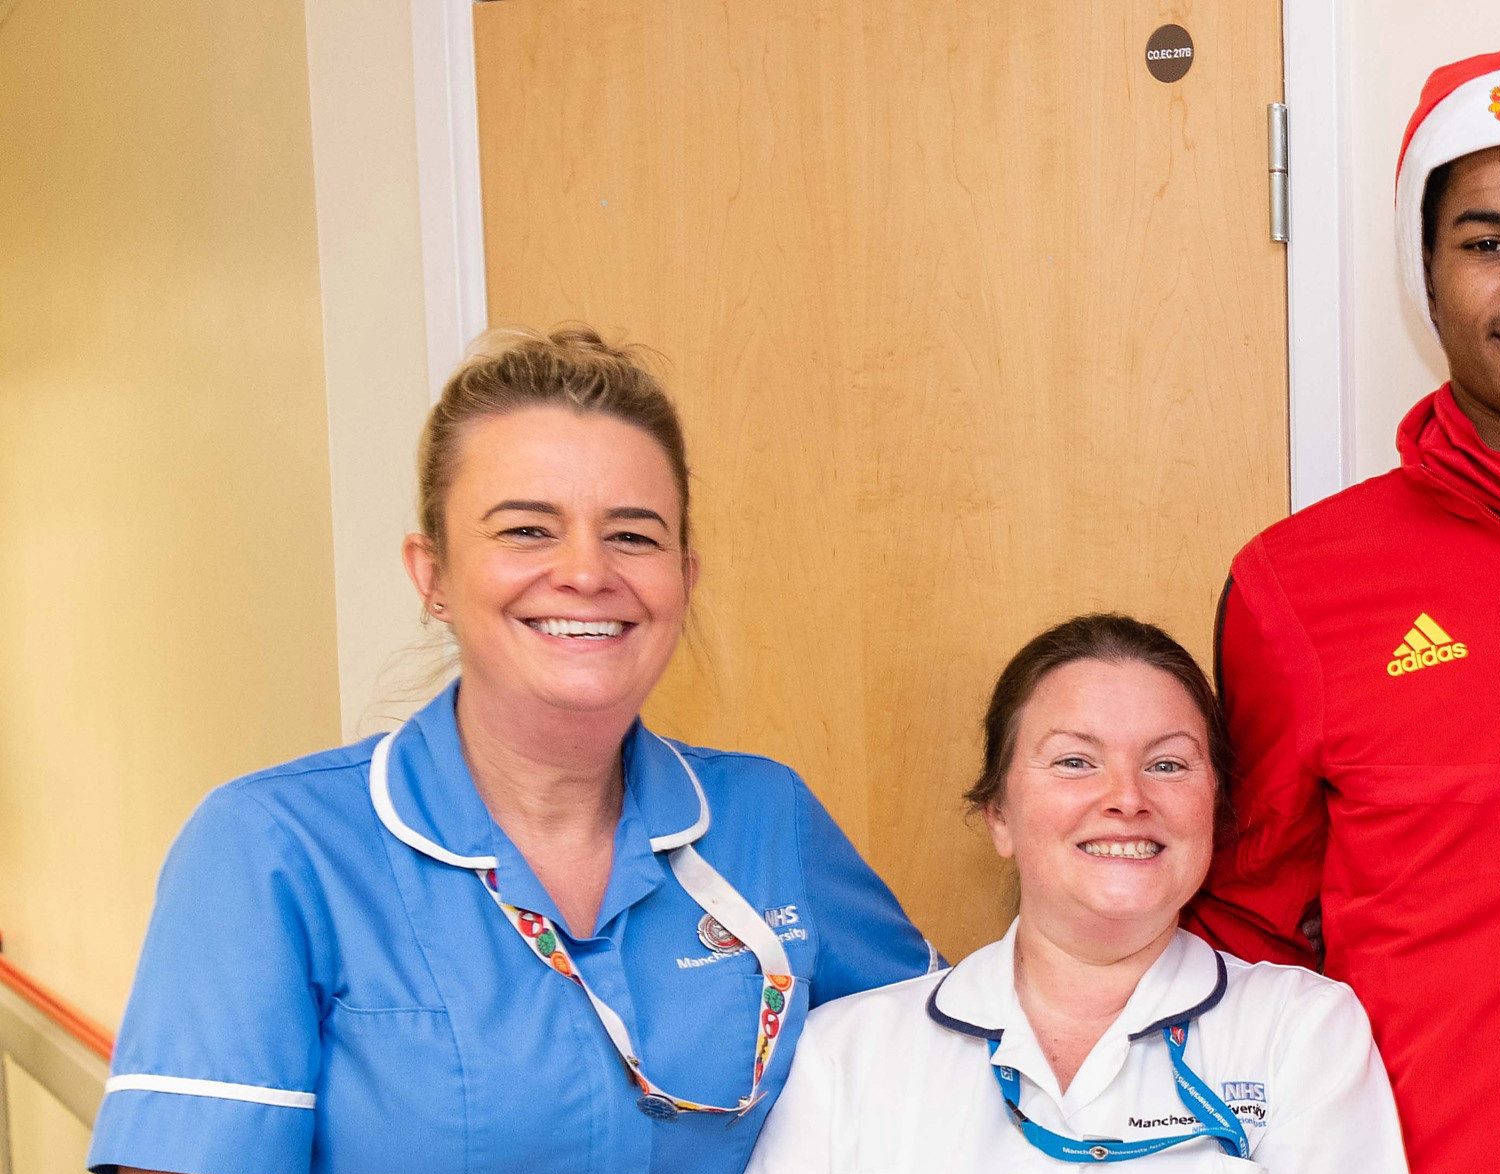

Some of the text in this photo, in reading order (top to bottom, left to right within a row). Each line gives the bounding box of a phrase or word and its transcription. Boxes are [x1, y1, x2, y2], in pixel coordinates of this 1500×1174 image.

[1386, 642, 1468, 676] adidas
[779, 928, 807, 944] rsity
[1224, 1083, 1264, 1101] NHS
[1129, 1114, 1201, 1128] Manches
[1062, 1146, 1093, 1156] Manch
